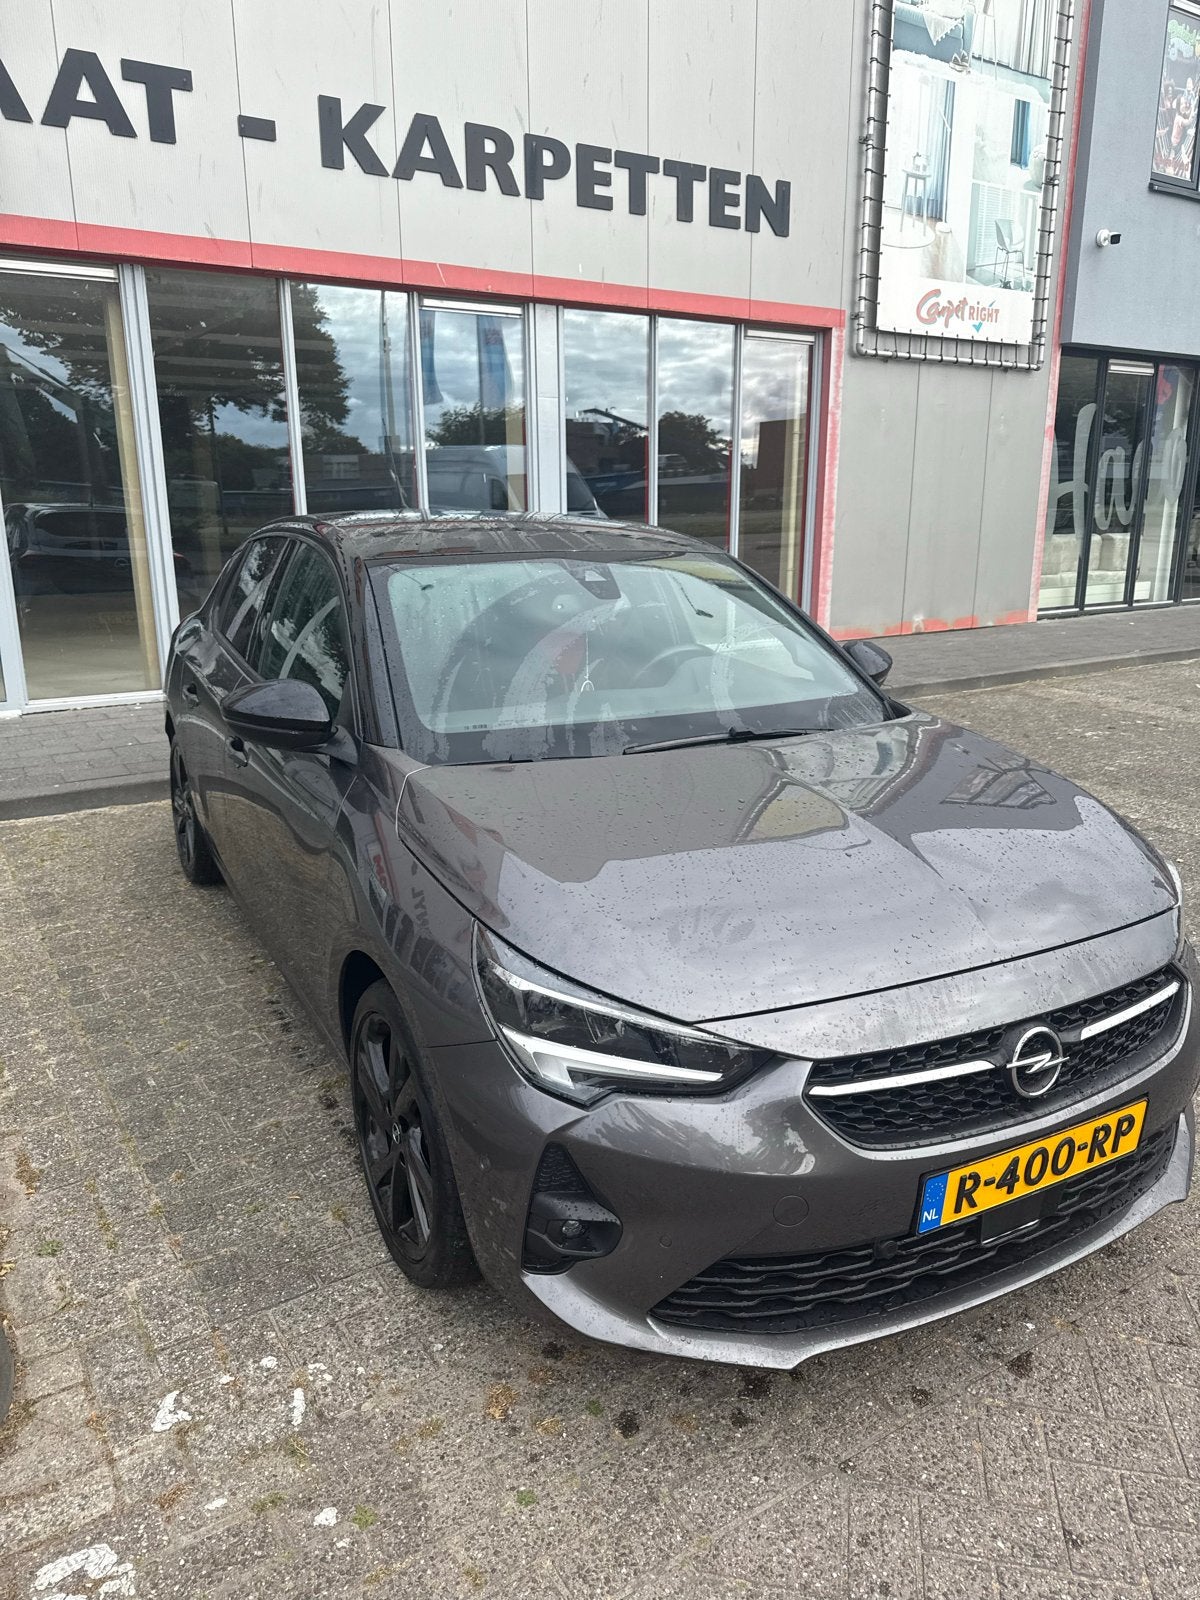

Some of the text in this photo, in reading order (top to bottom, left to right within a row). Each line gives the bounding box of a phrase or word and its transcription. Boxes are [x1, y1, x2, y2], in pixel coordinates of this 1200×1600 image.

[318, 94, 791, 238] KARPETTEN
[916, 288, 968, 329] Carpet
[922, 1113, 1136, 1222] NL R-400-RP
